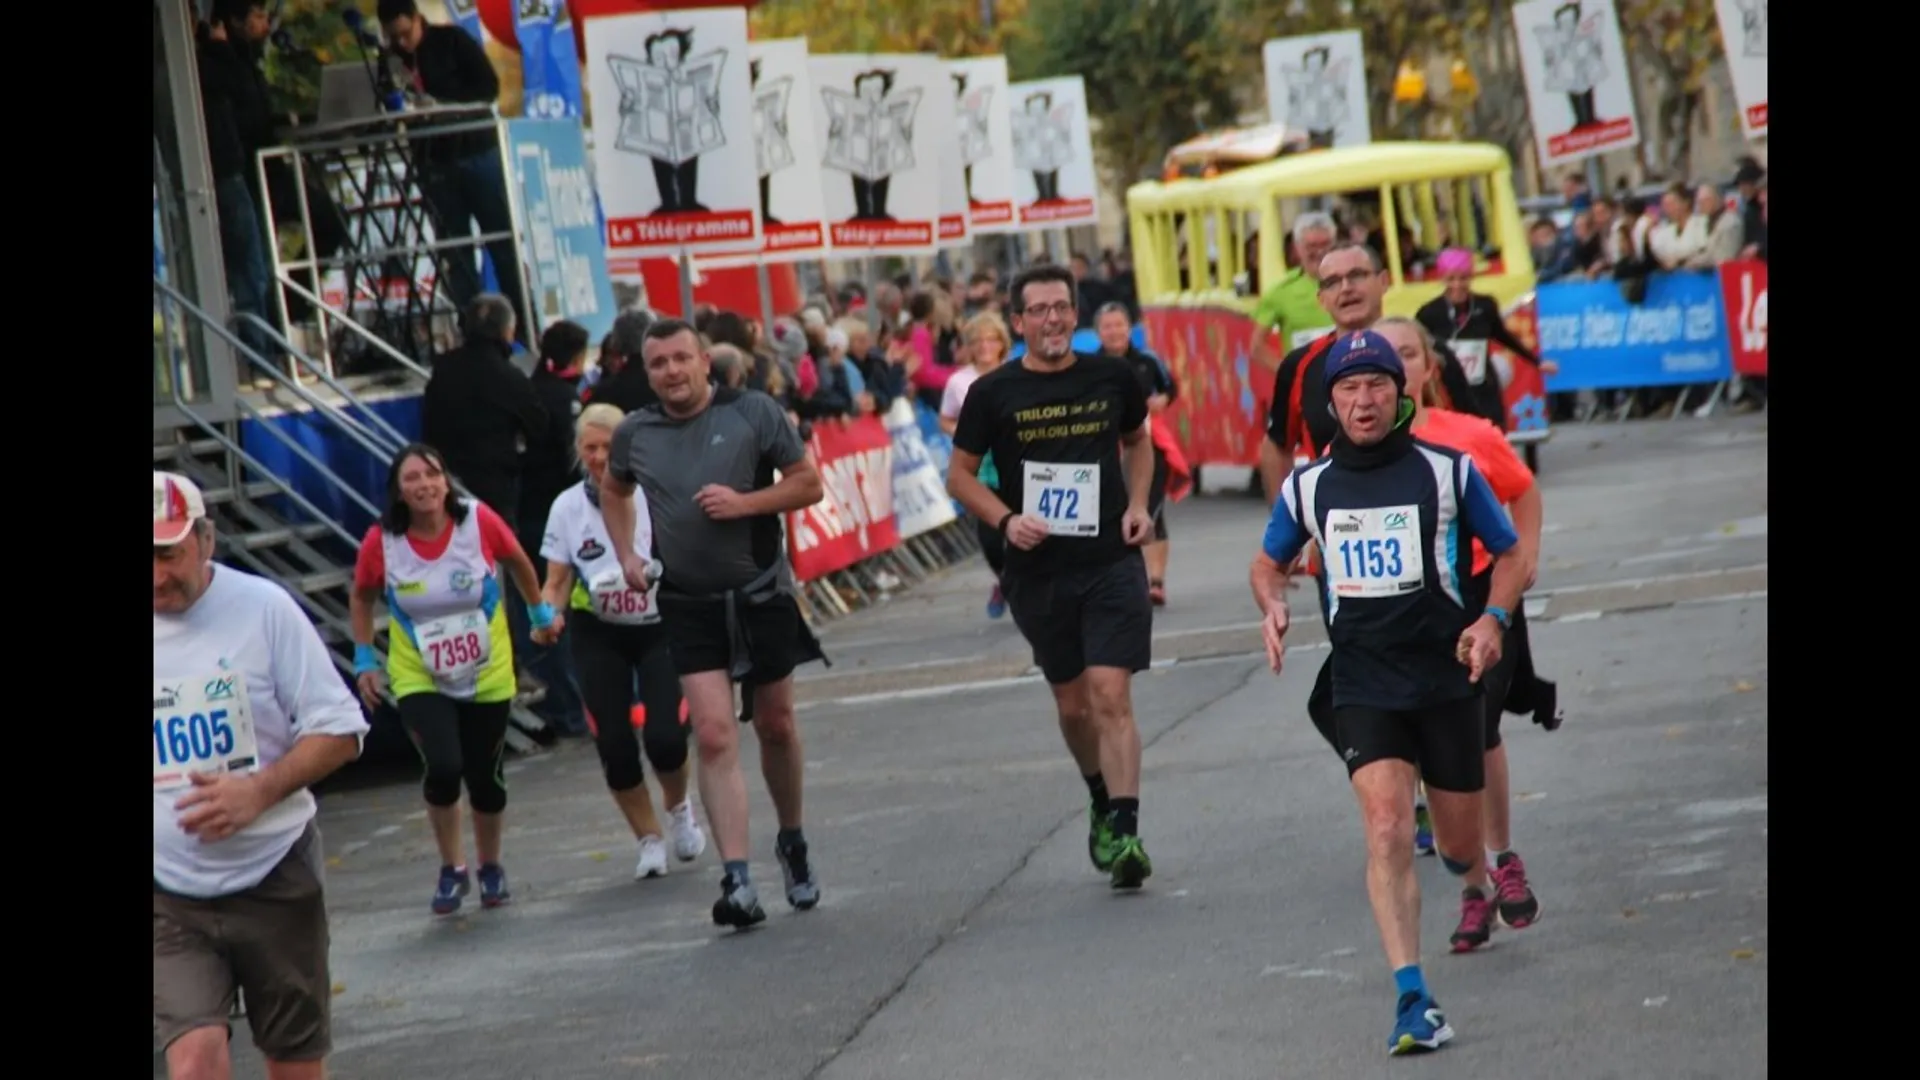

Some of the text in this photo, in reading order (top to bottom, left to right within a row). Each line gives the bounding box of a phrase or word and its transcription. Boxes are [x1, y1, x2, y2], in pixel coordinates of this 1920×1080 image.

[611, 218, 749, 242] Le Télégramme
[835, 226, 928, 244] Télégramme
[1038, 487, 1079, 519] 472
[1340, 537, 1402, 579] 1153
[598, 587, 648, 614] 7363
[428, 632, 481, 671] 7358
[153, 708, 234, 766] 1605
